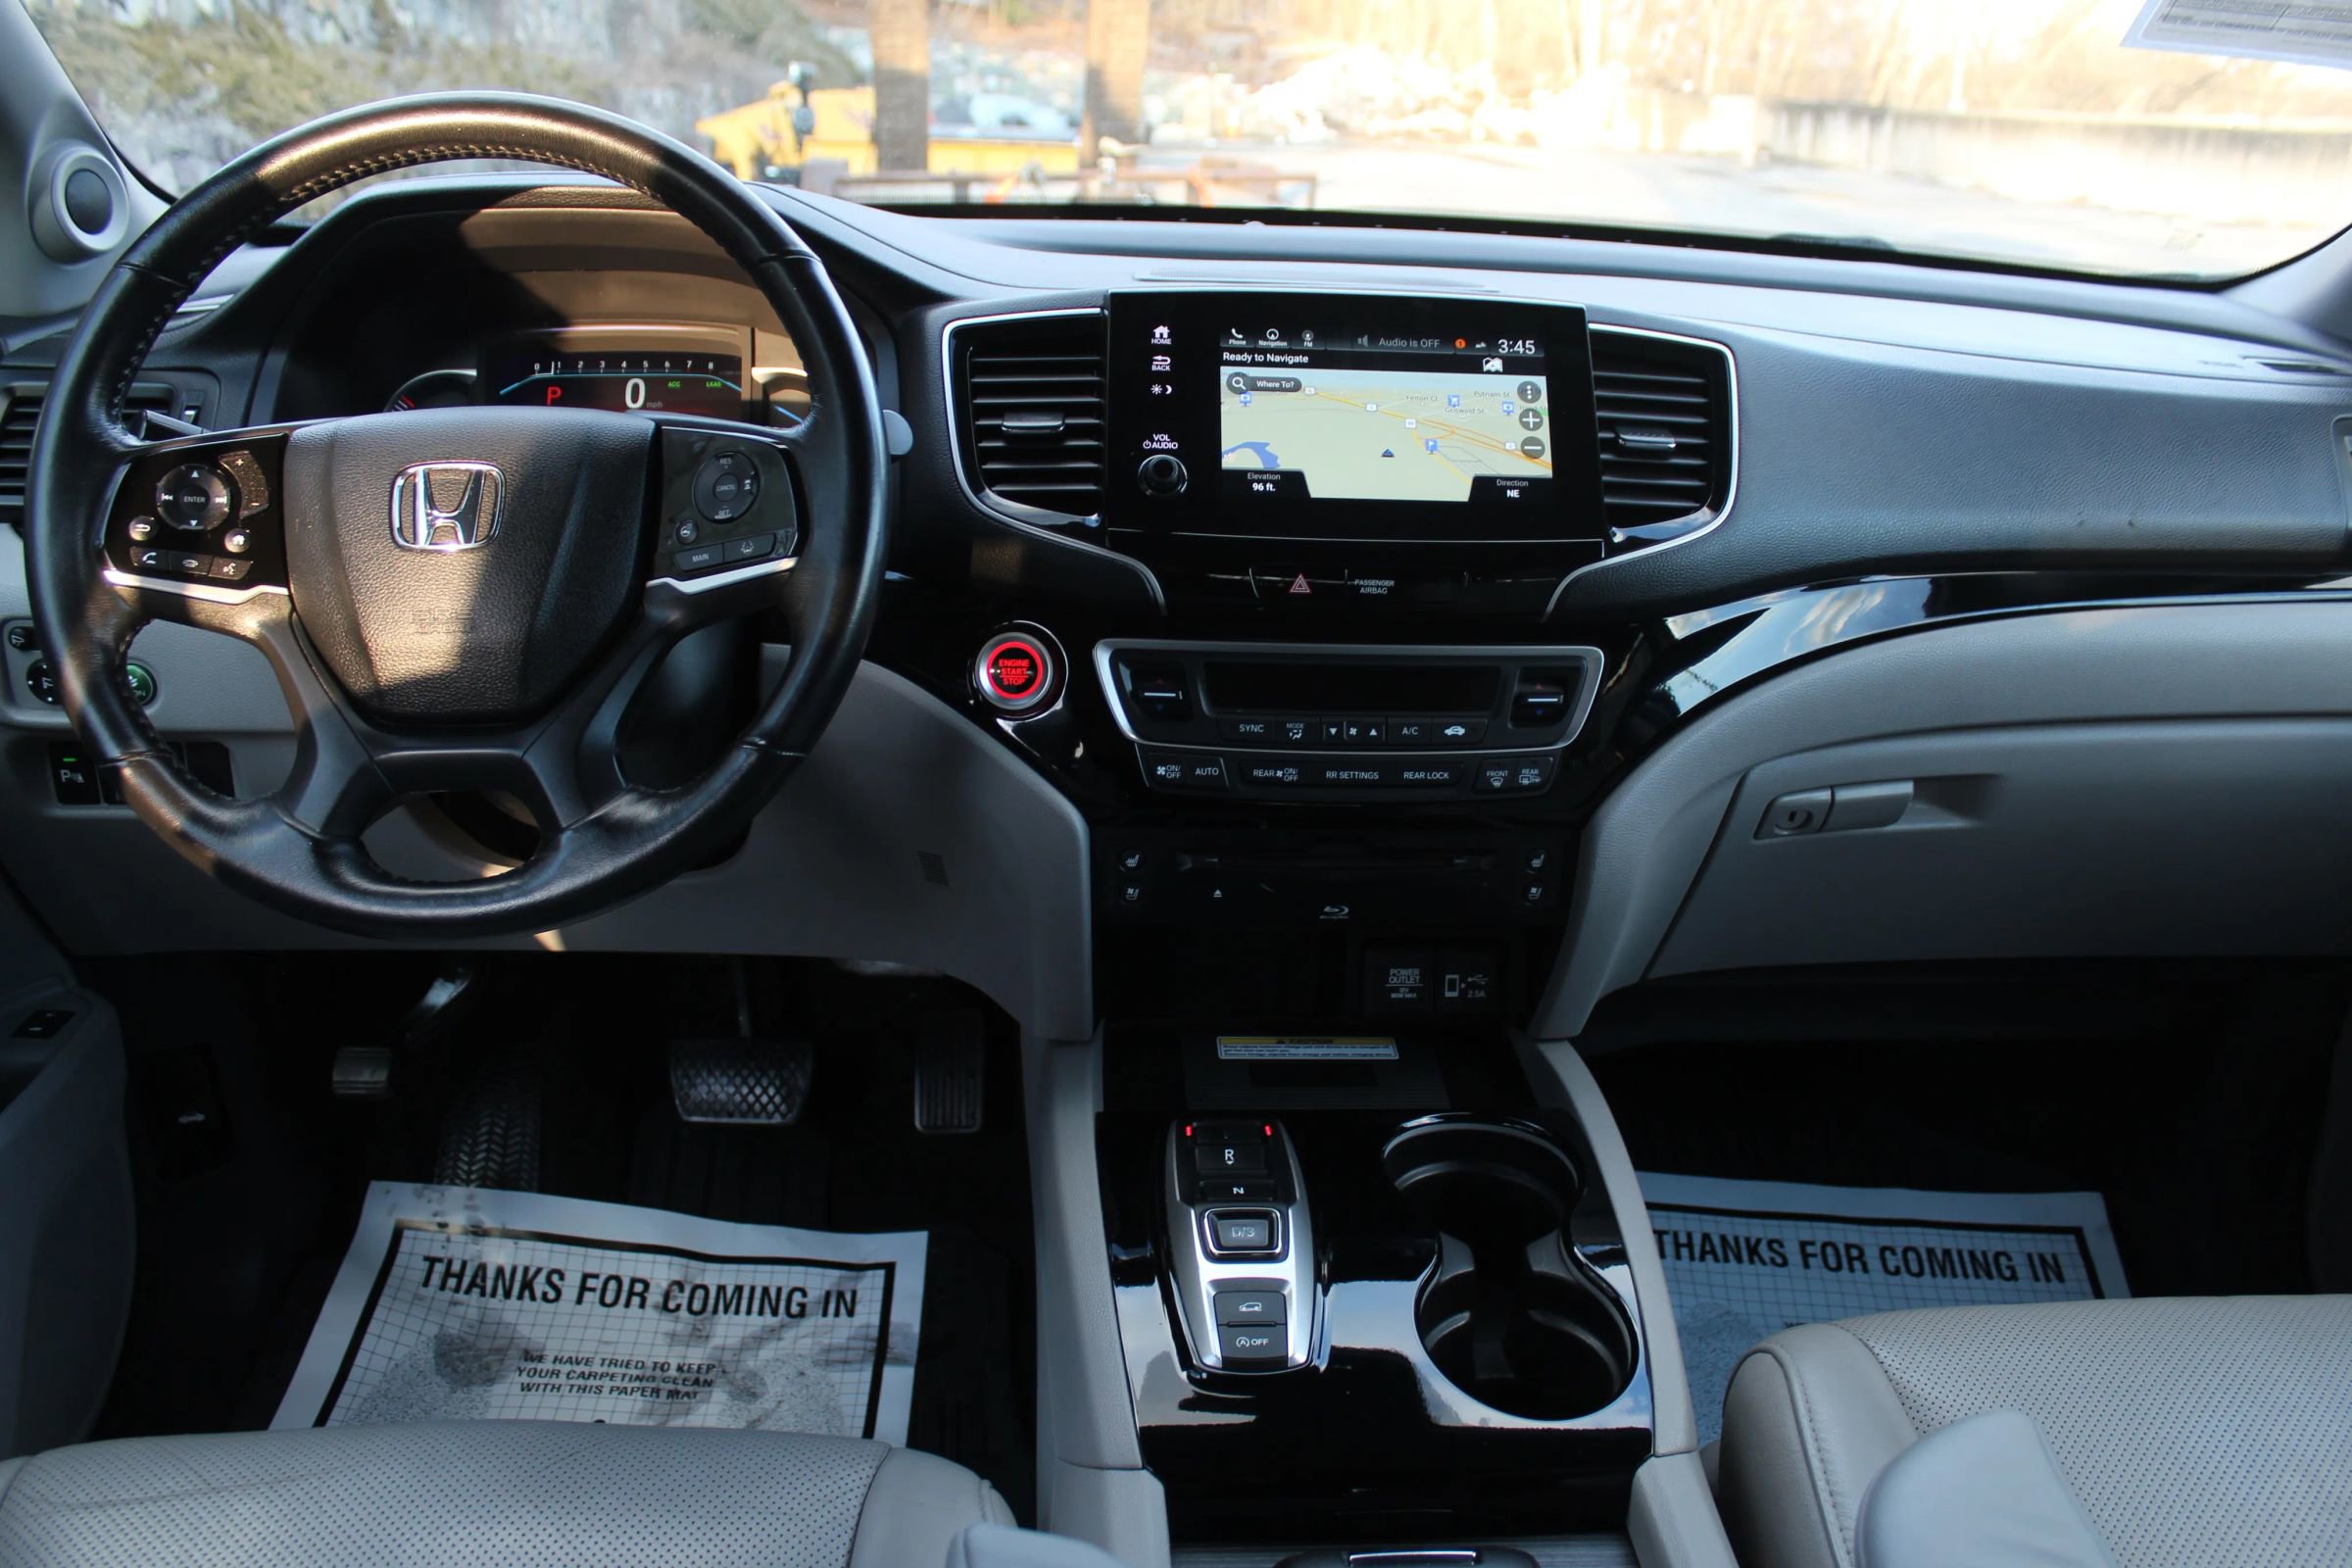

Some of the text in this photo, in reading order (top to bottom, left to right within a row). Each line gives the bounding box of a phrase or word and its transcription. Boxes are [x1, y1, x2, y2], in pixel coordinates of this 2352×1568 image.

[1379, 337, 1441, 349] Audio is OFF
[1497, 339, 1537, 355] 3:45
[1223, 352, 1309, 366] Ready to Navigate
[1152, 364, 1171, 372] BACK
[1256, 379, 1295, 389] Where To?
[546, 386, 562, 407] P
[624, 377, 646, 410] 0
[1152, 441, 1179, 450] AUDIO
[1247, 471, 1281, 481] Elevation
[1252, 482, 1276, 492] 96 ft.
[1496, 478, 1529, 487] Direction
[1506, 489, 1520, 499] NE
[183, 495, 206, 504] ENTER
[692, 553, 710, 563] MAIN
[1354, 578, 1395, 588] PASSENGER
[999, 659, 1030, 667] ENGINE
[1001, 667, 1028, 676] START
[1239, 723, 1264, 733] SYNC
[1401, 726, 1419, 736] A/C
[1195, 767, 1219, 776] AUTO
[1326, 770, 1380, 780] RR SETTINGS
[1403, 770, 1450, 780] REAR LOCK
[1389, 968, 1420, 977] POWER
[1224, 1150, 1234, 1160] R
[1231, 1226, 1255, 1238] D/S
[1652, 1229, 2067, 1284] THANKS FOR COMING IN
[418, 1255, 858, 1319] THANKS FOR COMING IN
[1250, 1338, 1269, 1347] OFF
[522, 1351, 717, 1375] WE HAVE TRIED TO KEEP
[516, 1365, 714, 1388] YOUR CARPETING CLEAN
[518, 1382, 700, 1401] WITH THIS PAPER MAT
